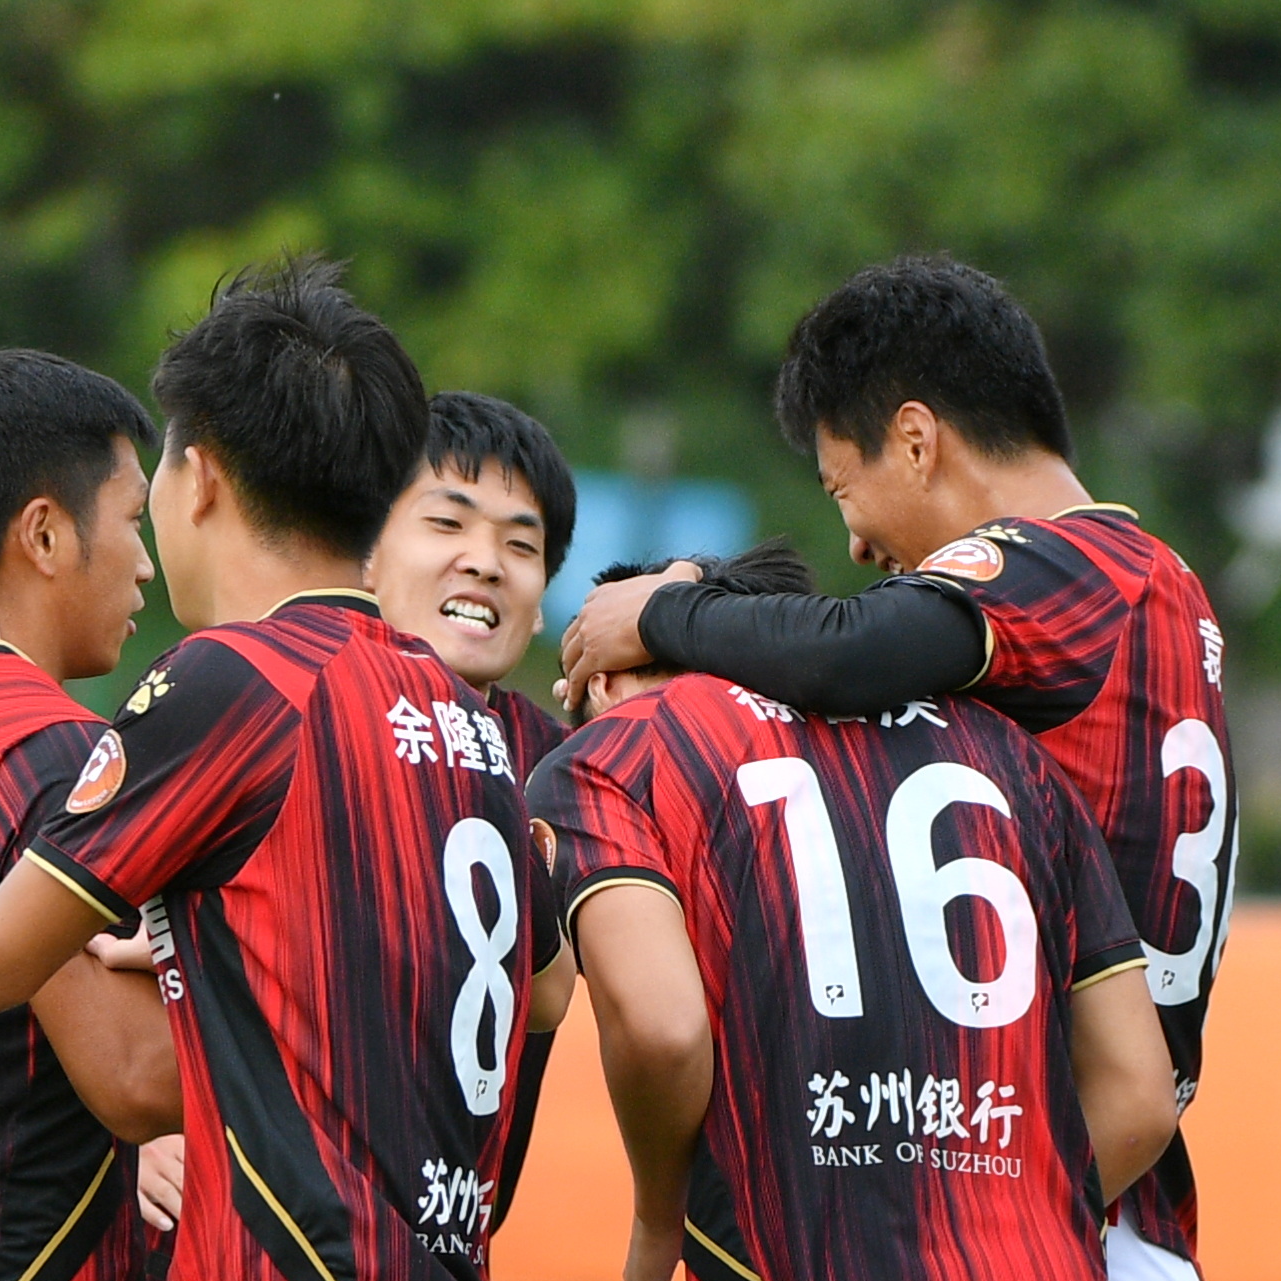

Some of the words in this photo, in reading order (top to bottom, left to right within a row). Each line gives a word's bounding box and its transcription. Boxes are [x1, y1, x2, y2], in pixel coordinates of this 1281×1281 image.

[443, 817, 518, 1117] 8
[736, 756, 1038, 1029] 16
[1140, 718, 1240, 1006] 3
[806, 1067, 1023, 1149] 苏州银行
[810, 1143, 884, 1168] BANK
[930, 1148, 1022, 1179] SUZHOU
